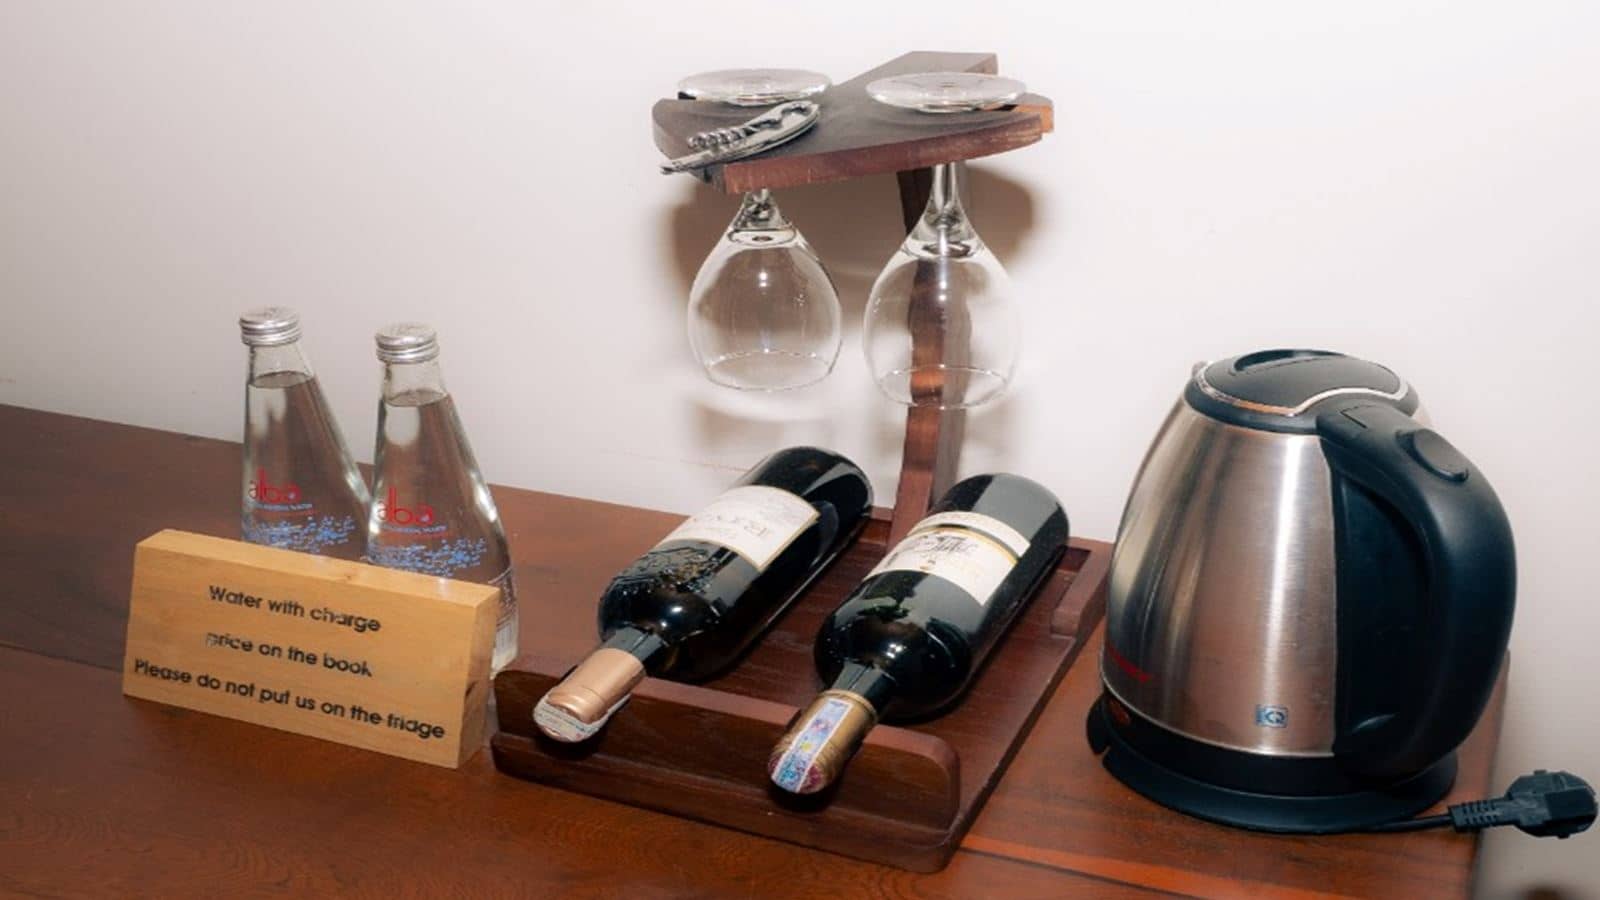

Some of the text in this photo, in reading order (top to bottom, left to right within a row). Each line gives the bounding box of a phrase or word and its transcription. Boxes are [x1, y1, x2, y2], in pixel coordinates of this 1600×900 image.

[209, 585, 381, 633] Water with charge
[258, 643, 282, 658] on
[287, 646, 317, 665] the
[323, 652, 372, 677] book
[134, 658, 192, 683] Please
[196, 674, 221, 690] do
[225, 681, 255, 697] not
[259, 688, 290, 704] put
[295, 696, 316, 711] us
[320, 702, 345, 717] on
[350, 705, 383, 725] the
